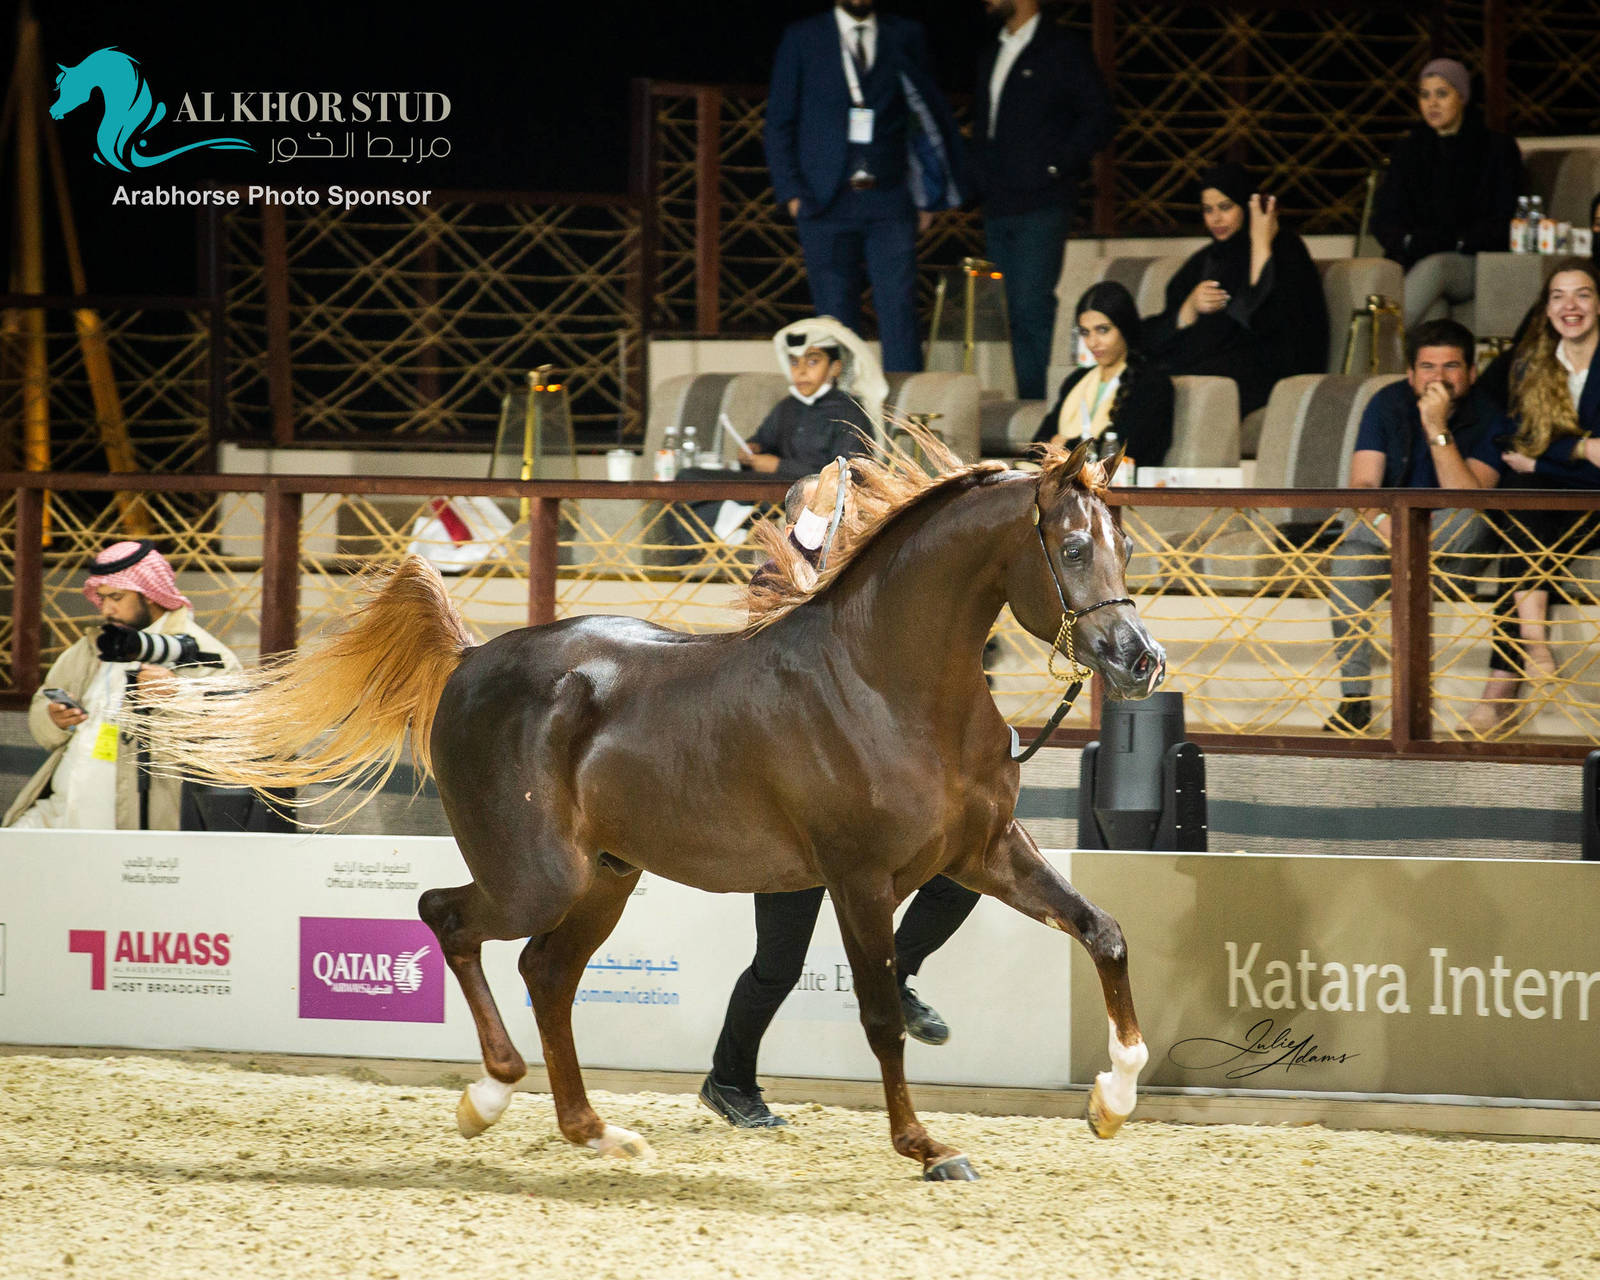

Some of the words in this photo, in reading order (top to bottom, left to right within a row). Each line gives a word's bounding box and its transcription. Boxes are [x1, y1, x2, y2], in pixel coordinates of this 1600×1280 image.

[114, 930, 230, 966] ALKASS
[313, 951, 393, 986] QATAR
[1225, 941, 1411, 1014] Katara
[112, 982, 143, 992] HOST
[147, 983, 231, 995] BROADCASTER
[574, 987, 679, 1005] ommunication
